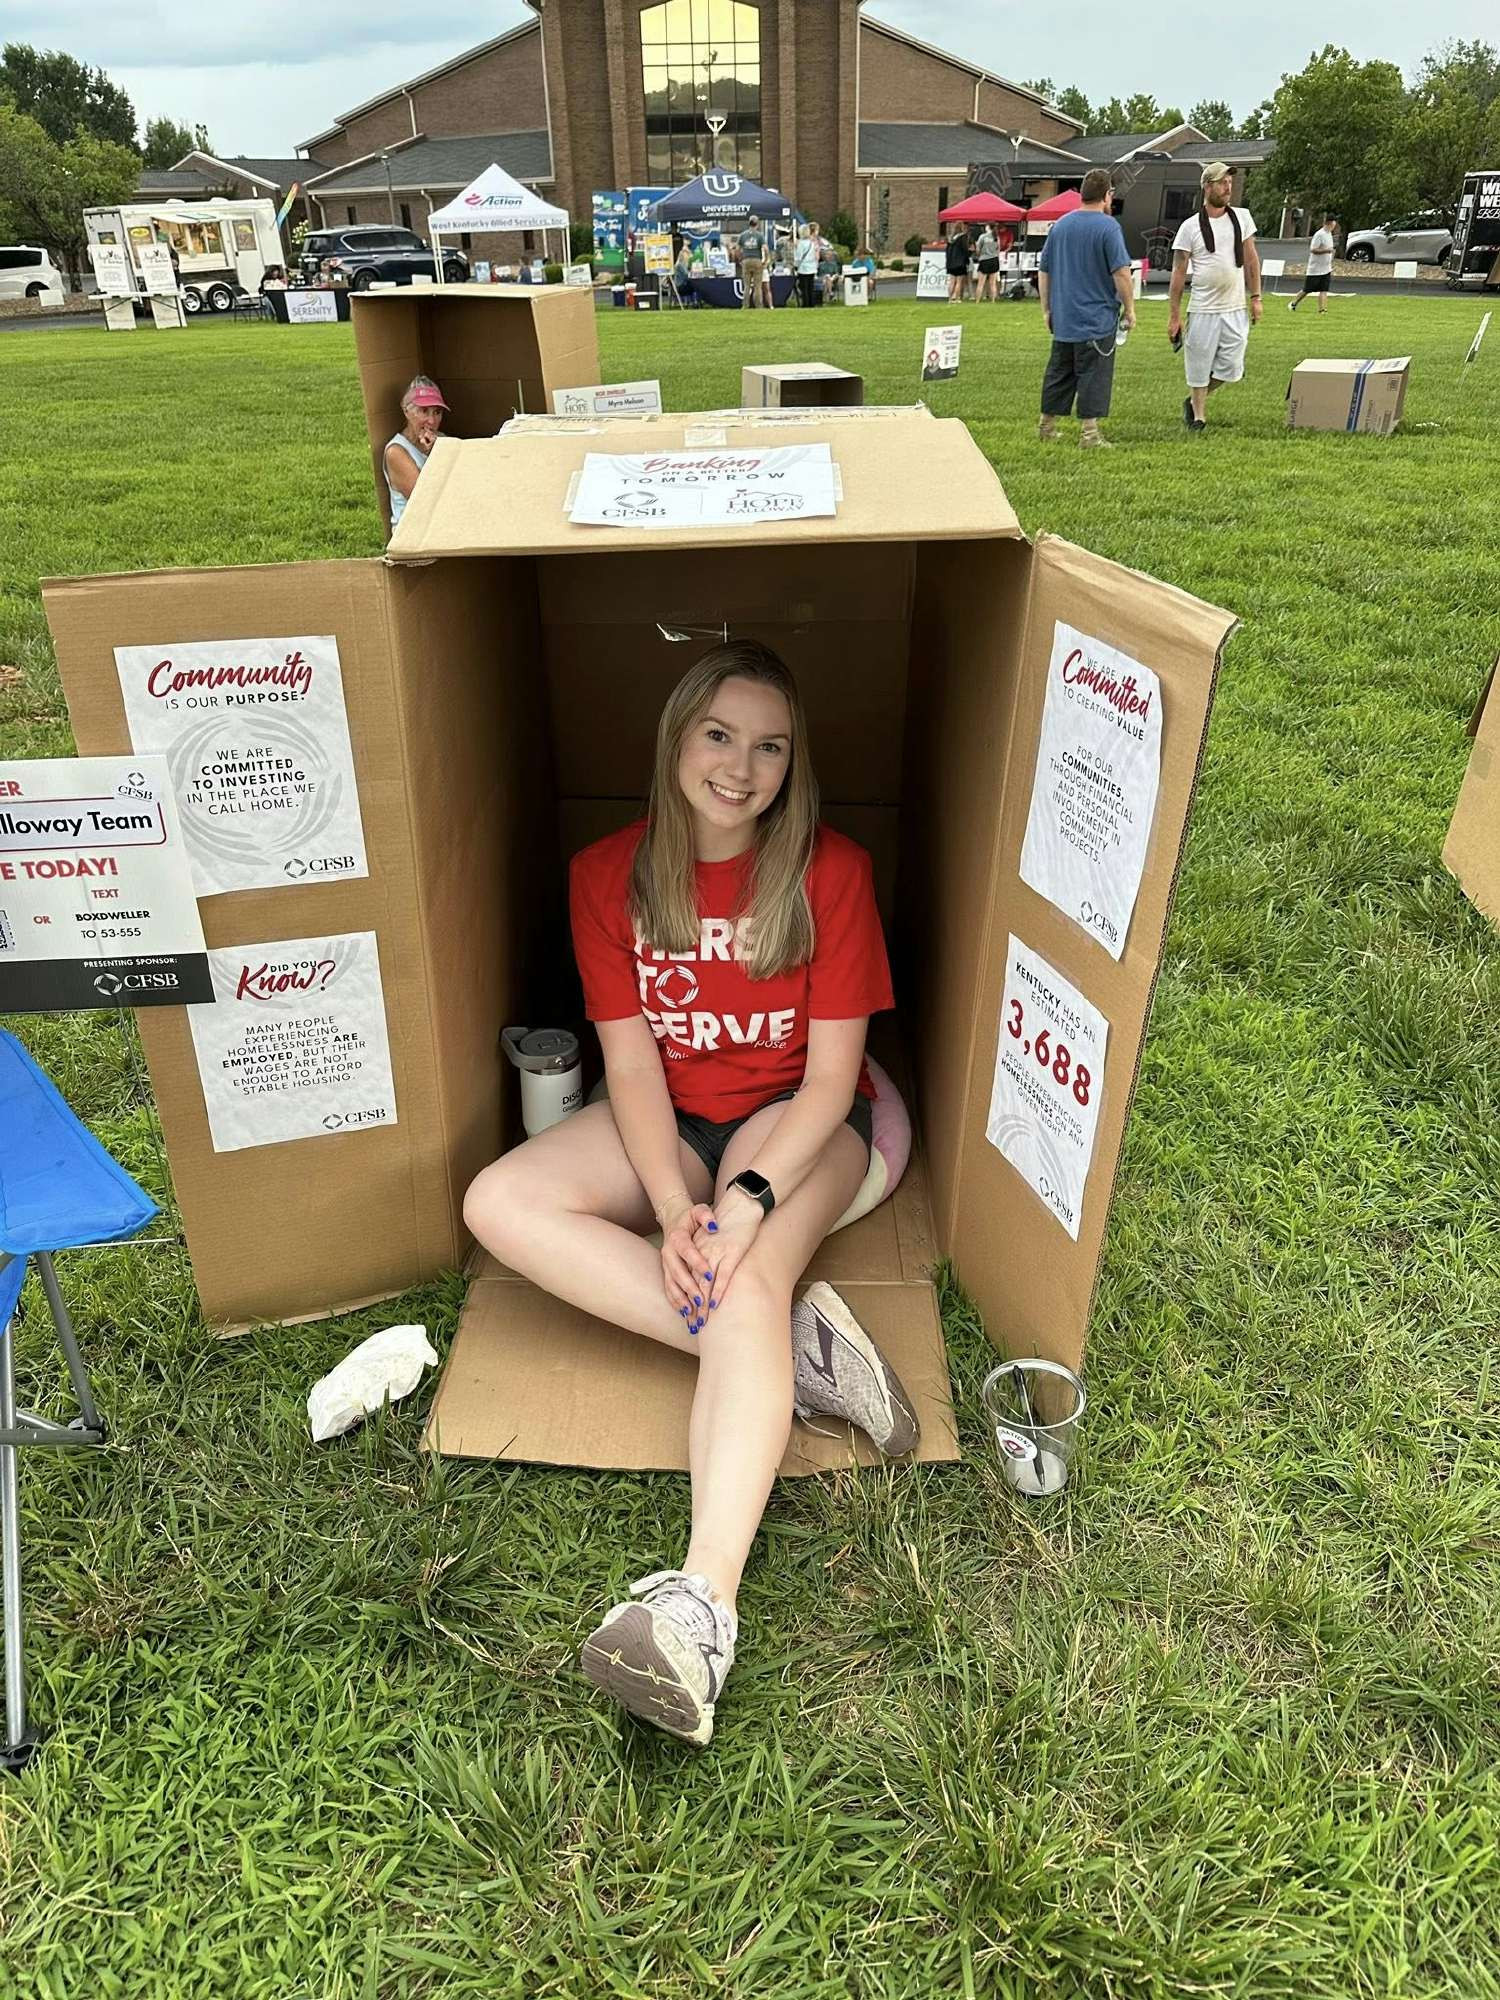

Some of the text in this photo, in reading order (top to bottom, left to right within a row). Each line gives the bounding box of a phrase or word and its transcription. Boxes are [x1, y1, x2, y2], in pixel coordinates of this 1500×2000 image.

[480, 195, 523, 206] Action
[702, 204, 751, 213] UNIVERSITY
[431, 221, 450, 230] West
[452, 219, 489, 229] Kentucky
[292, 306, 332, 316] SERENITY
[642, 456, 762, 474] Banking
[621, 472, 785, 484] TOMORROW
[602, 508, 666, 518] CFSB
[728, 499, 805, 509] HOPE
[147, 651, 313, 698] Community
[1087, 656, 1116, 681] WE ARE
[1063, 649, 1153, 723] Committed
[165, 690, 305, 710] IS OUR PURPOSE.
[1063, 685, 1145, 741] TO CREATING VALUE
[216, 747, 273, 761] WE ARE
[1077, 745, 1113, 776] FOR OUR
[201, 758, 293, 776] COMMITTED
[193, 771, 306, 790] TO INVESTING
[1050, 757, 1134, 824] THROUGH FINANCIAL
[117, 785, 153, 800] CFSB
[187, 783, 317, 804] IN THE PLACE WE
[208, 798, 300, 815] CALL HOME.
[1058, 780, 1120, 831] AND PERSONAL
[0, 811, 153, 837] lloway Team
[1052, 790, 1121, 847] INVOLVEMENT IN
[1059, 810, 1109, 853] COMMUNITY
[20, 857, 119, 880] TODAY!
[309, 855, 355, 872] CFSB
[91, 888, 119, 900] TEXT
[33, 915, 52, 925] OR
[75, 910, 151, 922] BOXDWELLER
[81, 927, 142, 939] TO 53-555
[1093, 912, 1119, 943] CFSB
[634, 918, 758, 961] RE
[84, 957, 179, 969] PRESENTING SPONSOR:
[270, 960, 318, 973] DID YOU
[124, 973, 180, 989] CFSB
[236, 959, 337, 1001] Know?
[1016, 961, 1096, 1044] KENTUCKY HAS AN
[246, 1015, 336, 1035] MANY PEOPLE
[1031, 991, 1076, 1041] ESTIMATED
[245, 1025, 339, 1045] EXPERIENCING
[641, 1008, 796, 1050] SERVE
[227, 1032, 359, 1057] HOMELESSNESS ARE
[303, 1046, 327, 1058] BUT
[331, 1040, 367, 1054] THEIR
[1007, 998, 1091, 1106] 3,688
[233, 1061, 363, 1087] ENOUGH TO AFFORD
[244, 1053, 349, 1076] WAGES ARE NOT
[243, 1072, 356, 1096] STABLE HOUSING.
[1005, 1050, 1082, 1134] PEOPLE EXPERIENCING
[1001, 1058, 1085, 1150] HOMELESSNESS ON ANY
[1017, 1086, 1062, 1137] GIVEN NIGHT
[344, 1108, 386, 1123] CFSB
[1050, 1190, 1074, 1223] CFSB
